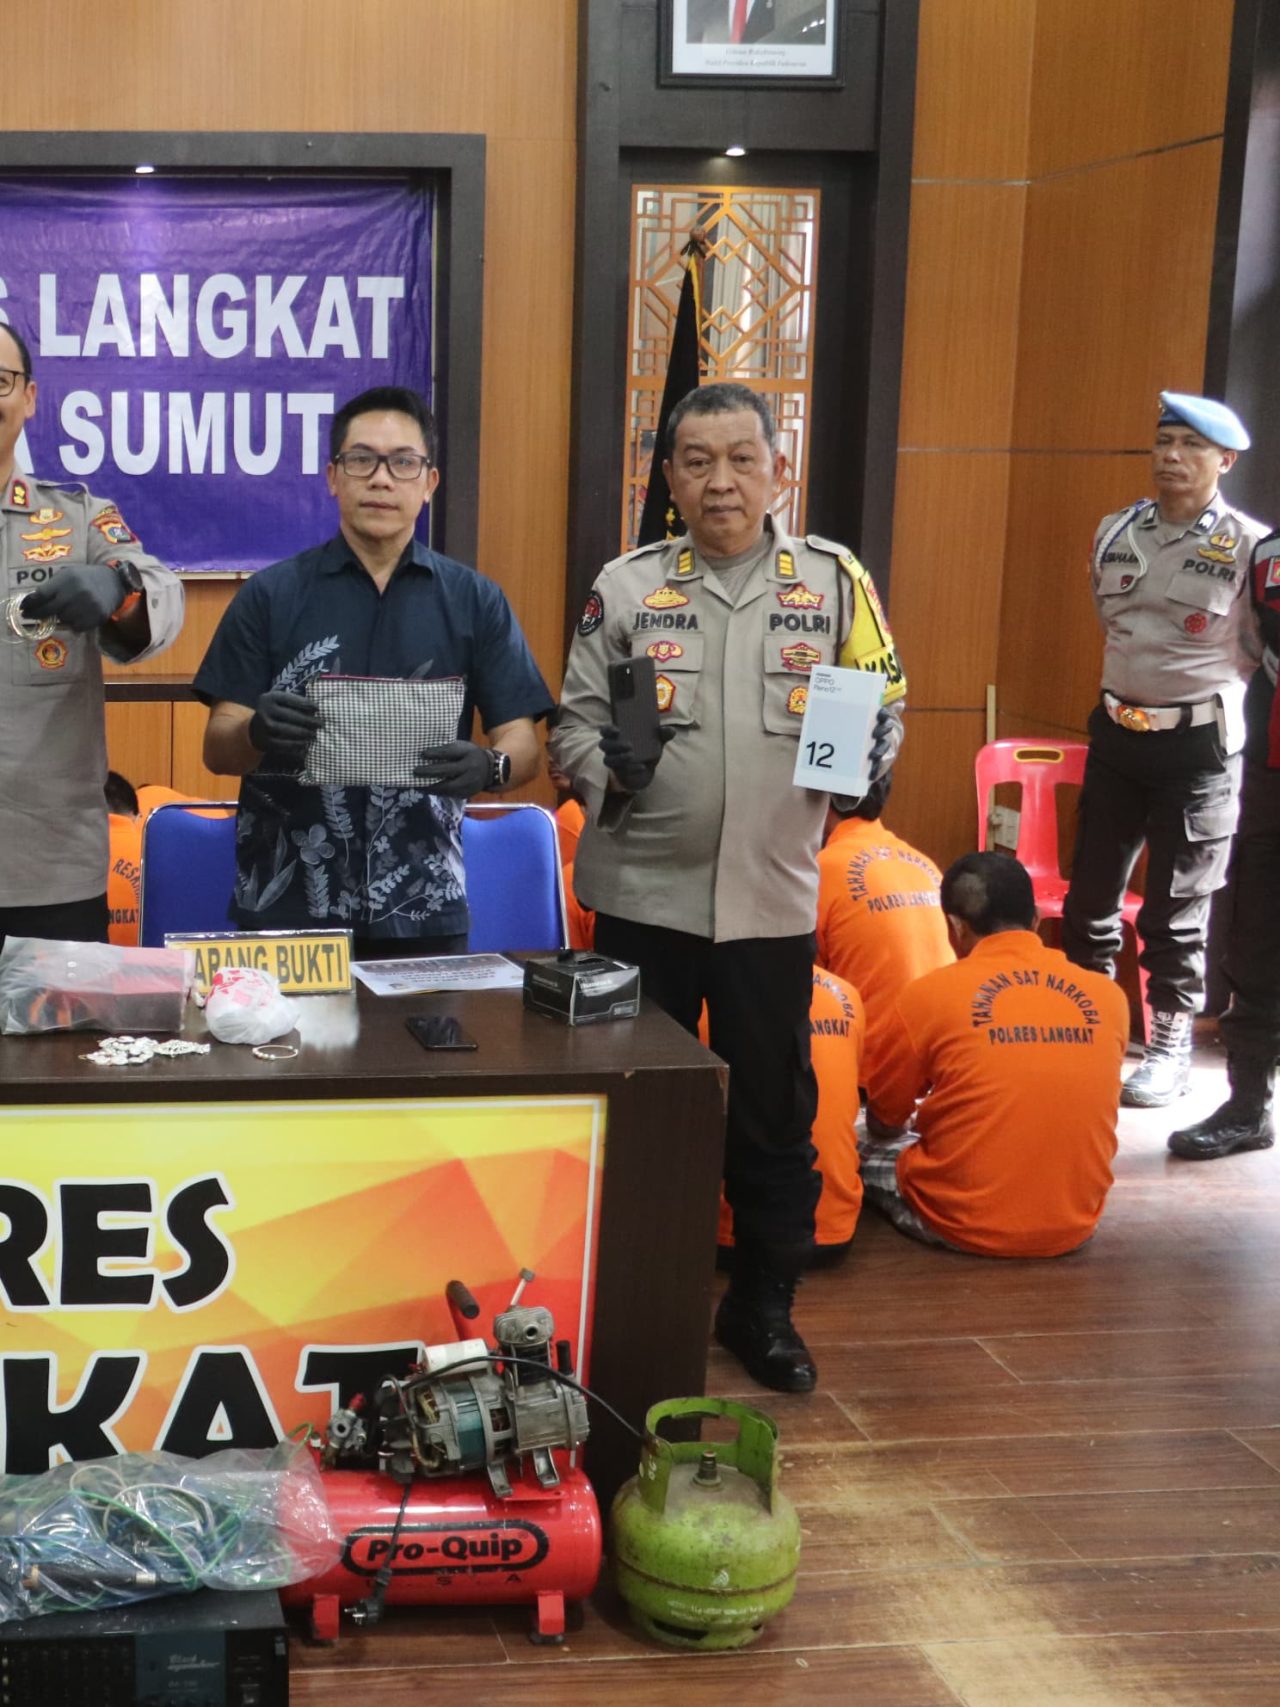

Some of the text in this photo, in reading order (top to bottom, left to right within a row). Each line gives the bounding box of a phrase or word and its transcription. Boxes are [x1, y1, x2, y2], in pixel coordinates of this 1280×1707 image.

[39, 272, 404, 359] LANGKAT
[59, 390, 334, 476] SUMUT
[1183, 558, 1237, 582] POLRI
[632, 612, 699, 631] JENDRA
[770, 612, 831, 634] POLRI
[814, 677, 835, 686] OPPO
[806, 741, 835, 768] 12
[194, 943, 344, 986] ARANG BUKTI
[971, 970, 1101, 1028] TAHANAN SAT NARKOBA
[989, 1027, 1094, 1045] POLRES LANGKAT
[367, 1532, 523, 1562] Pro-Quip
